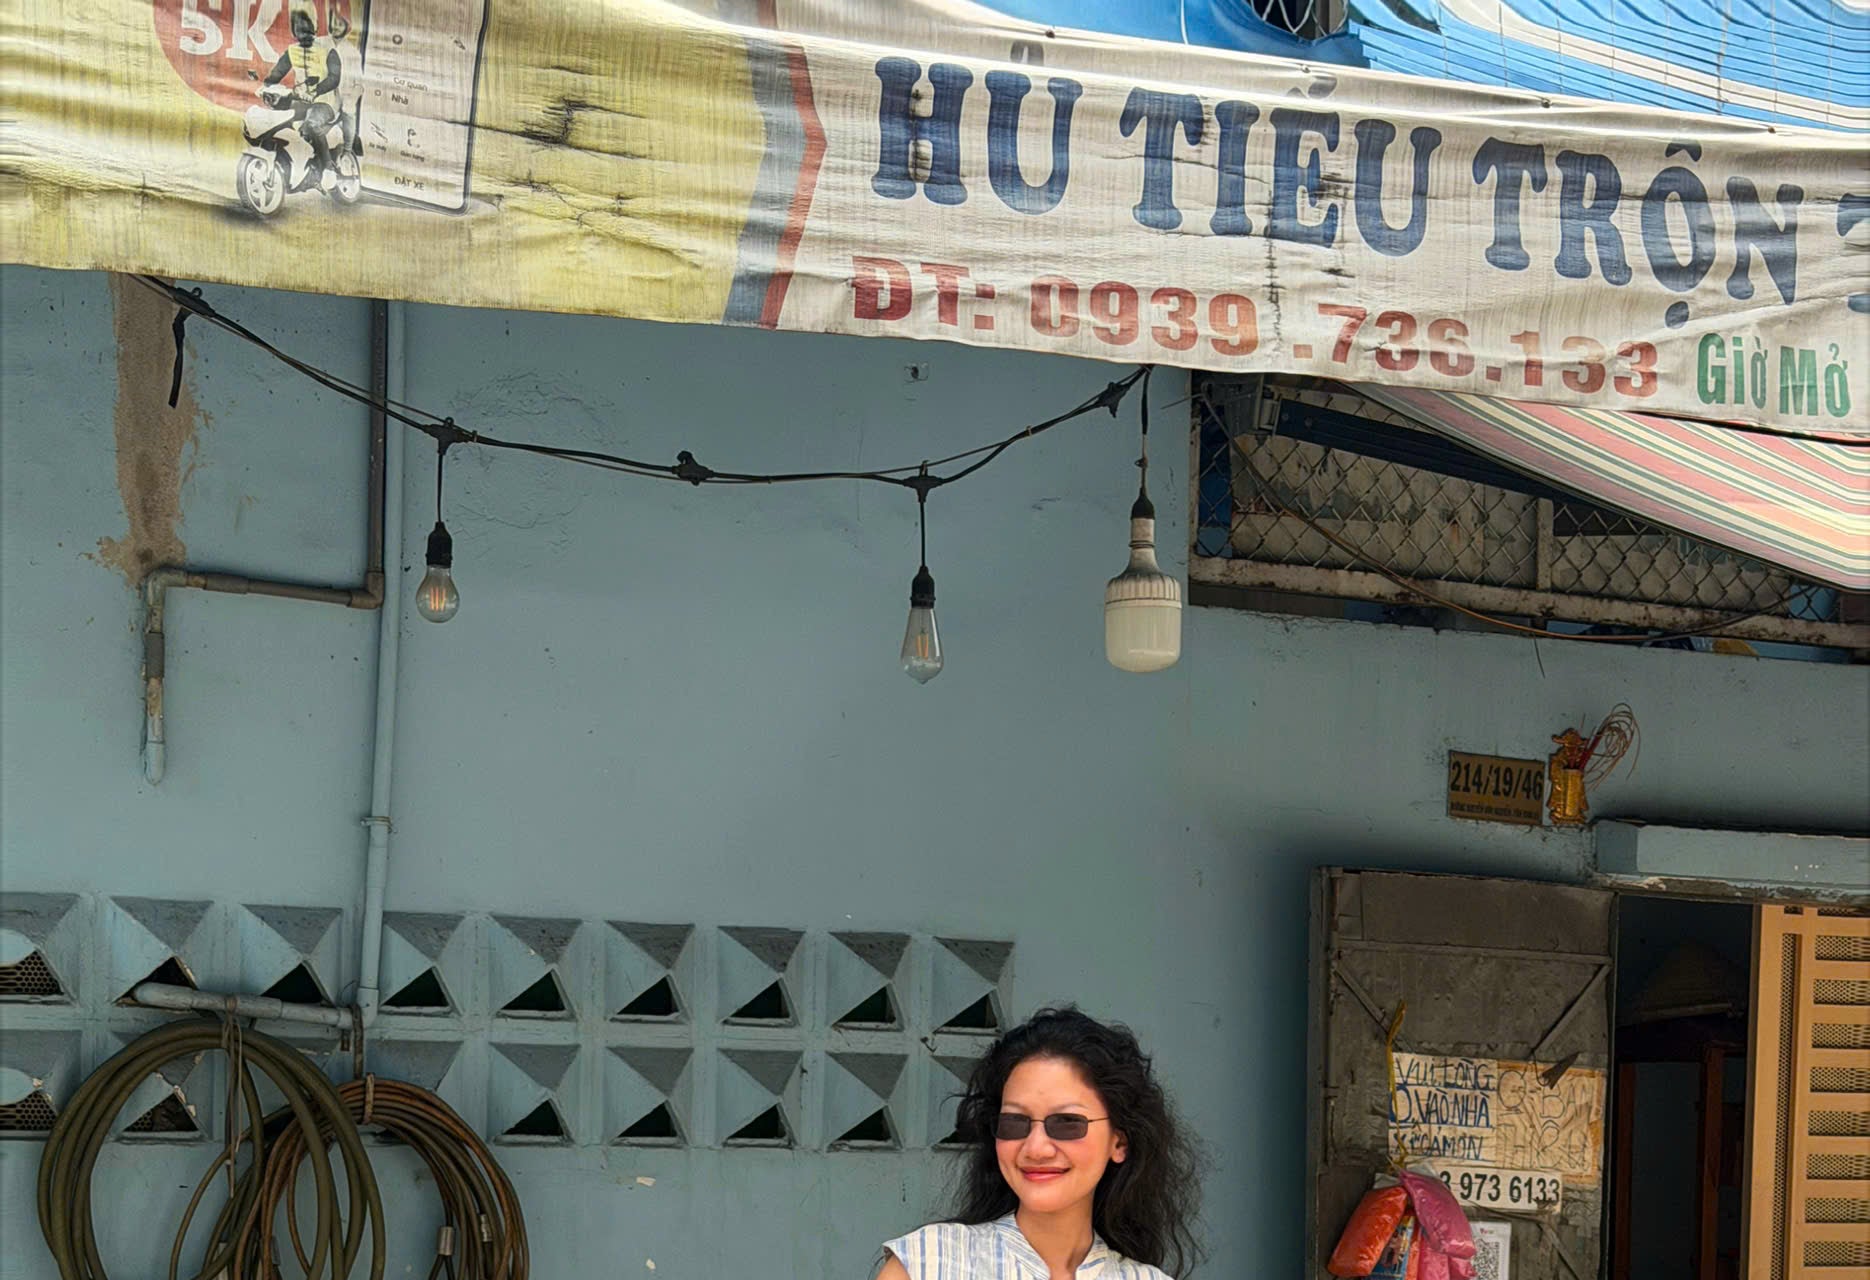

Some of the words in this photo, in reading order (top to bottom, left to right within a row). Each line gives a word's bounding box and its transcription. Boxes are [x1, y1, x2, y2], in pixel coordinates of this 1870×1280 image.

[1471, 137, 1805, 329] TRỘN
[1697, 332, 1768, 409] Giờ
[1779, 342, 1852, 418] Mở
[1450, 759, 1544, 801] 214/19/46
[1459, 1172, 1501, 1202] 973
[1509, 1175, 1560, 1206] 6133
